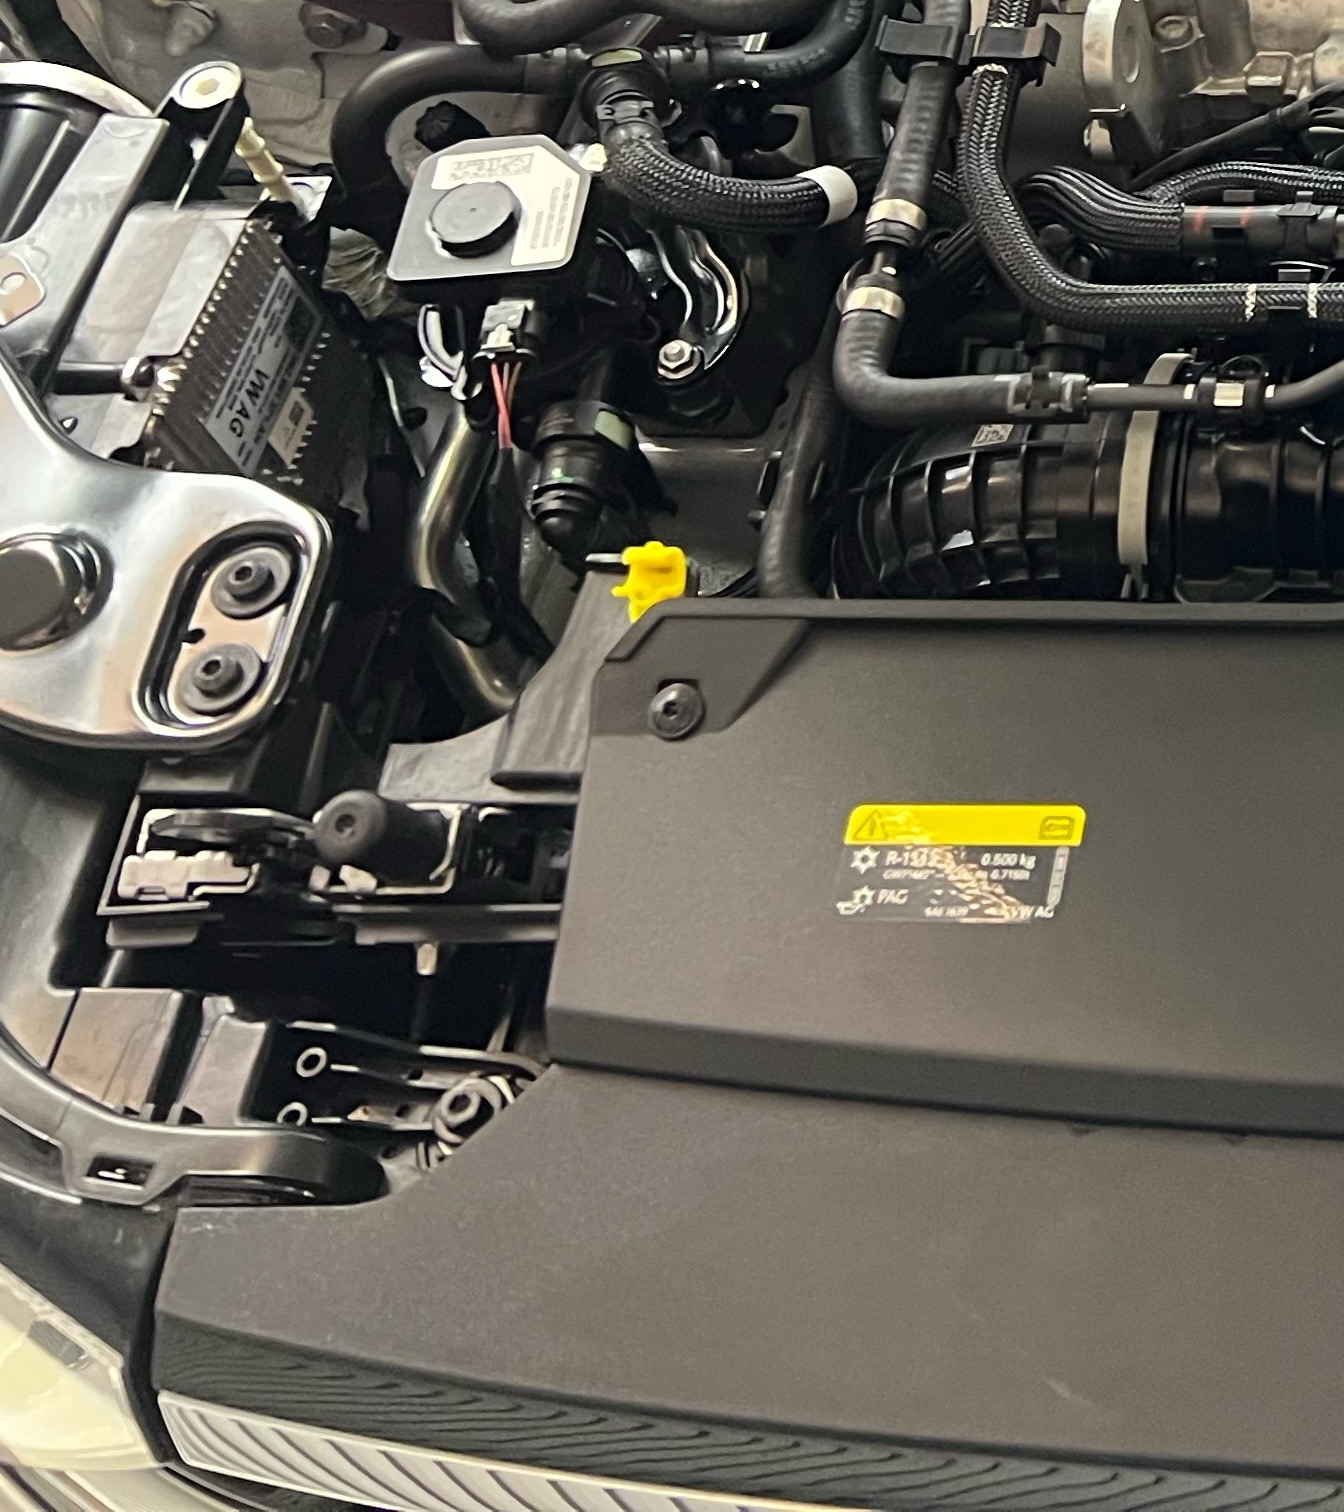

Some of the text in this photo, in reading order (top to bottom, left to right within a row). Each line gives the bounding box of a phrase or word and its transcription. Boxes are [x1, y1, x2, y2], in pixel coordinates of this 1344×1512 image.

[245, 369, 269, 407] VW
[229, 399, 251, 438] AG
[1019, 852, 1037, 870] kg
[877, 889, 910, 905] PAG
[1034, 905, 1055, 919] AG
